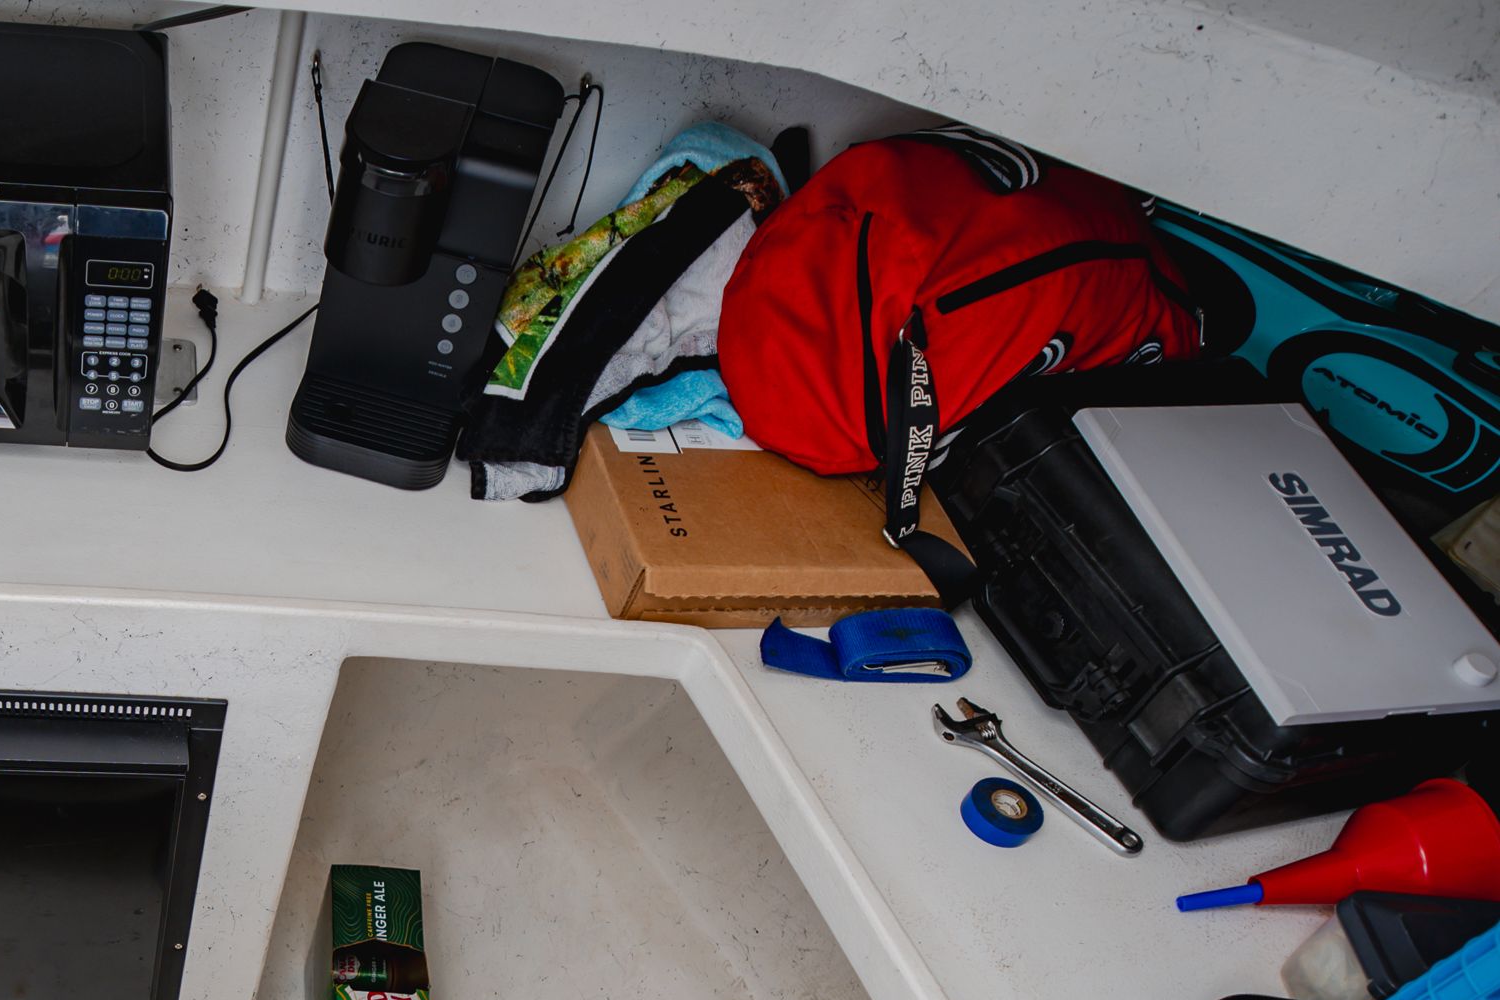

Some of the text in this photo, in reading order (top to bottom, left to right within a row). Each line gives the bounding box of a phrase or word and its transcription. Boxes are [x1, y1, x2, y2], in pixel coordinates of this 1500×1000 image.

[107, 267, 141, 281] 0:00
[911, 347, 932, 407] PIN
[637, 456, 687, 537] STARLIN
[901, 425, 933, 509] PINK
[1268, 472, 1401, 617] SIMRAD
[373, 881, 388, 941] INGER ALE
